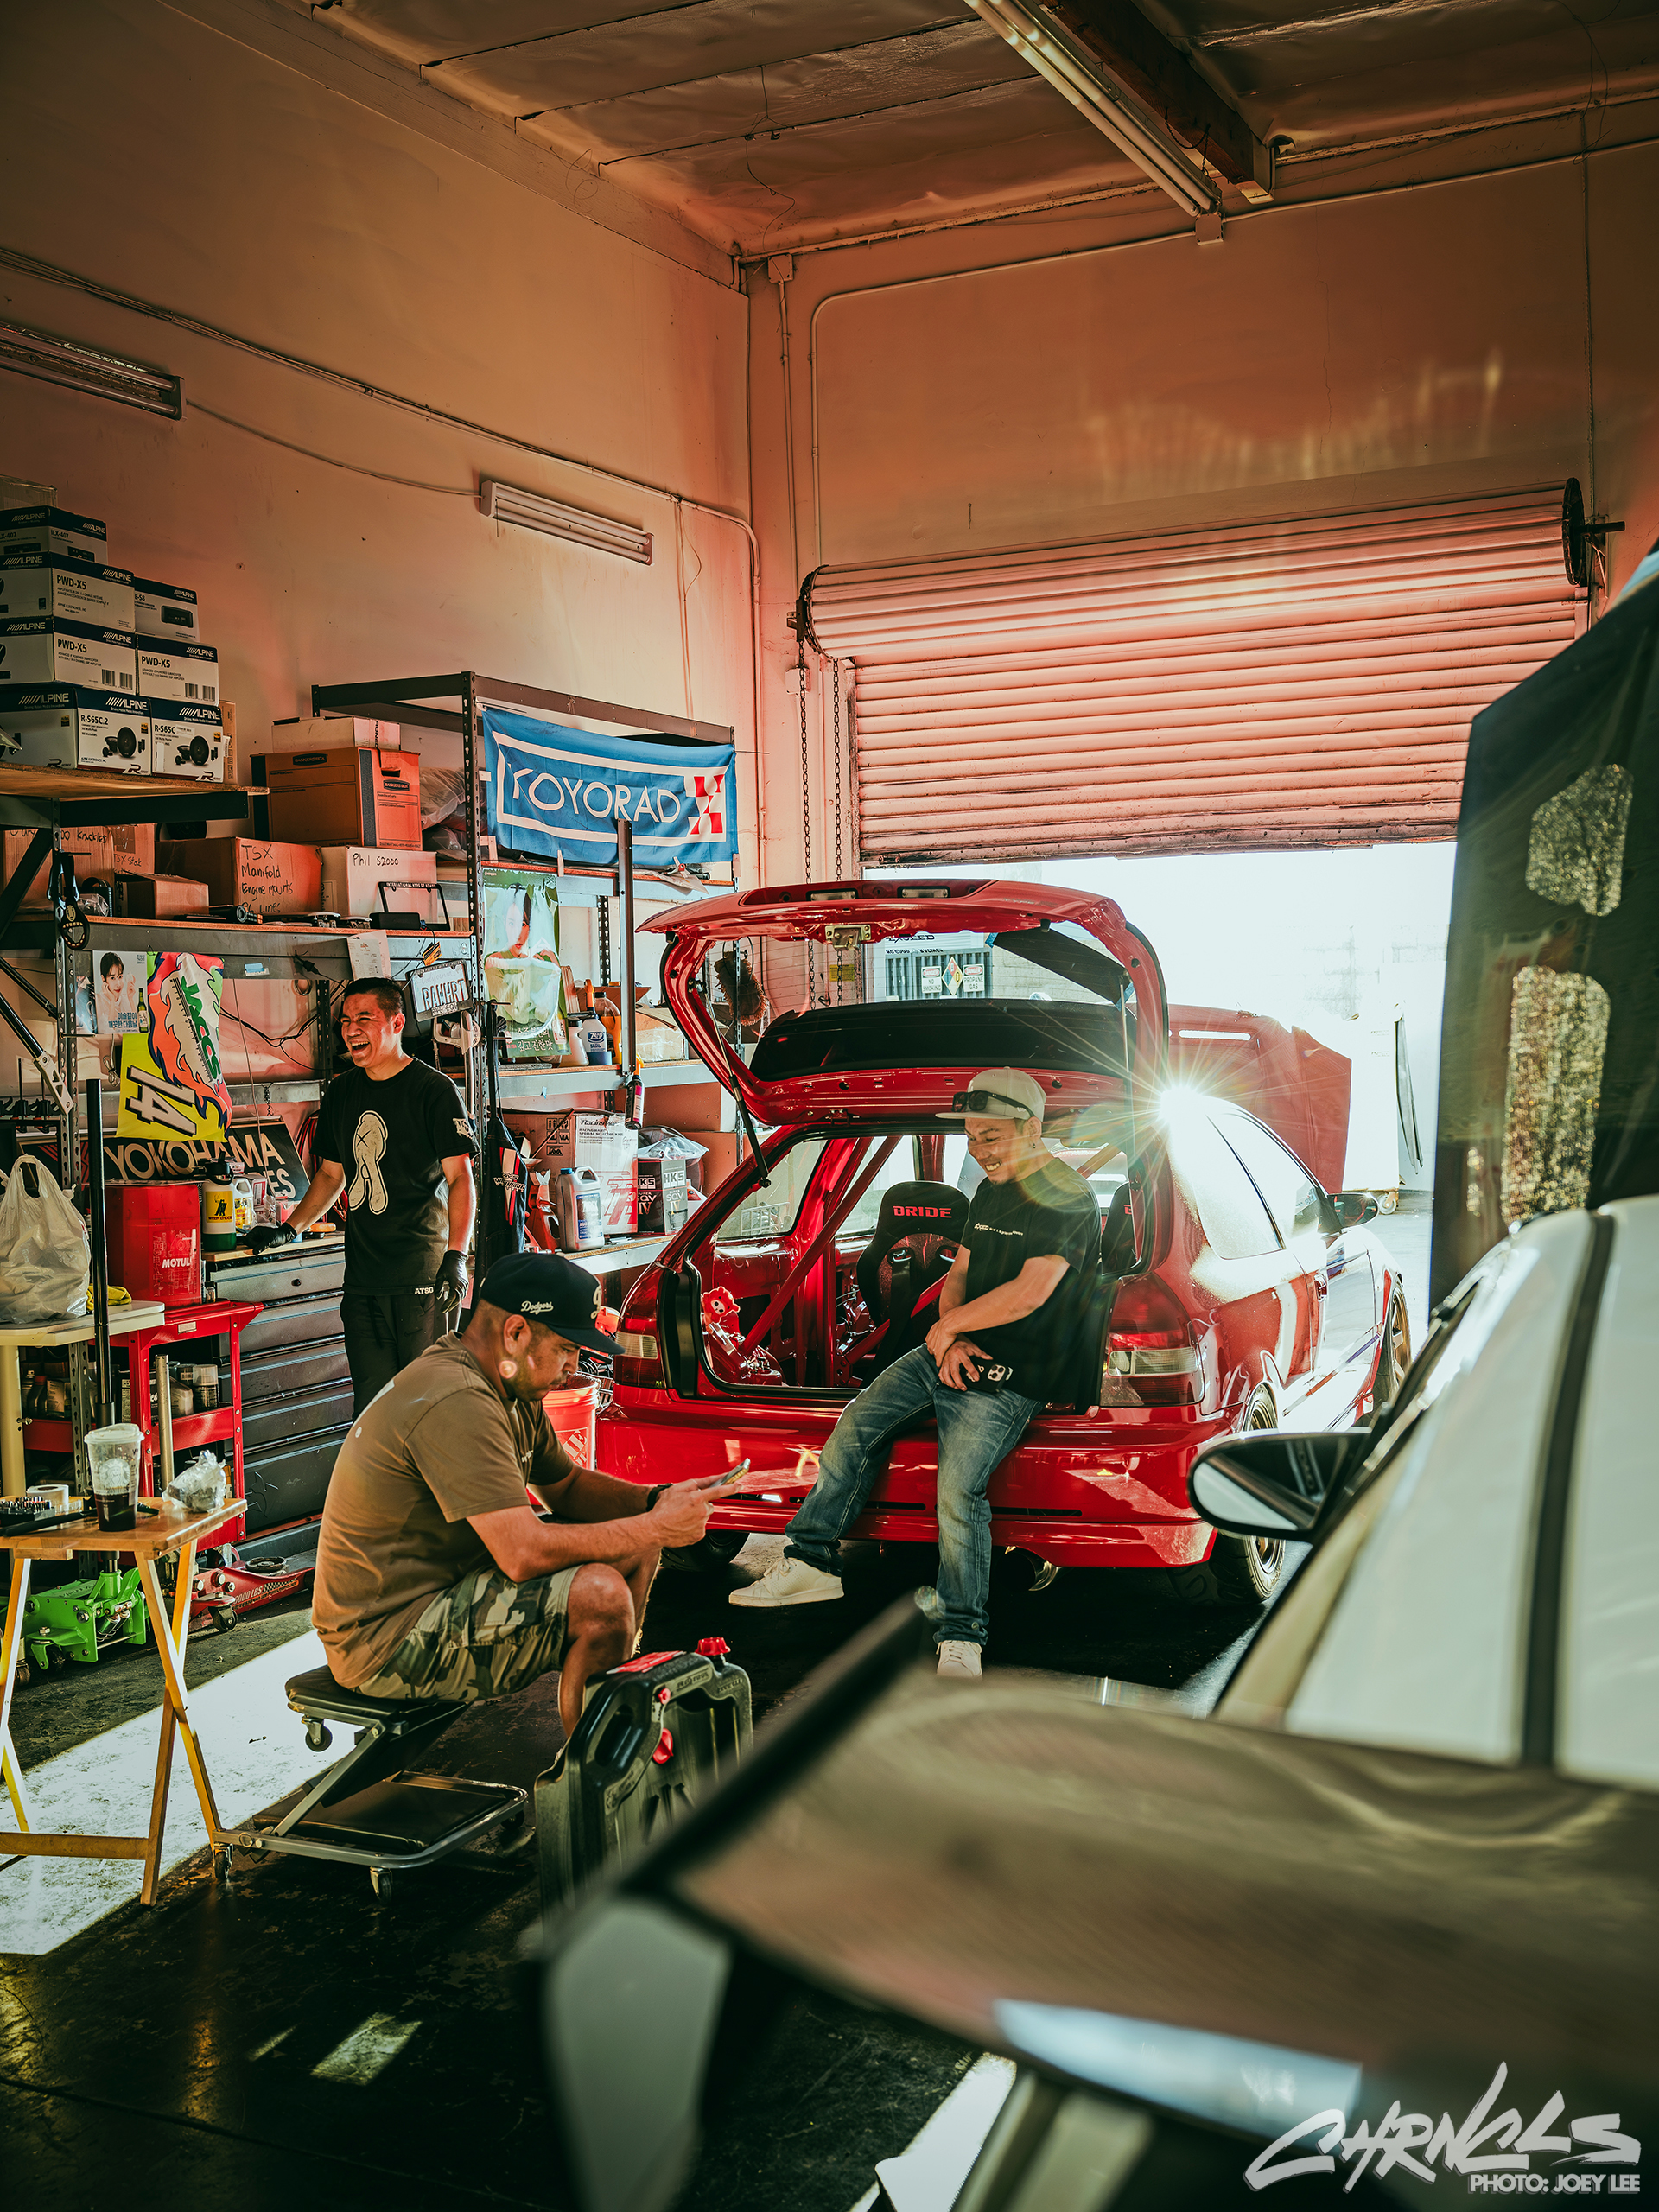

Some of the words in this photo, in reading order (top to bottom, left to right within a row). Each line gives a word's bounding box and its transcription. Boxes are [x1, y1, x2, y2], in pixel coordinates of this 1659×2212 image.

[16, 556, 43, 564] ALPINE
[56, 575, 87, 589] PWD-X5
[112, 571, 131, 582] ALPINE
[112, 633, 131, 644] ALPINE
[57, 639, 87, 653] PWD-X5
[194, 649, 214, 658] ALPINE
[141, 656, 171, 668] PWD-X5
[35, 693, 69, 704] ALPINE
[119, 698, 149, 710] ALPINE
[192, 708, 220, 720] ALPINE
[77, 831, 107, 843] Knuckles
[241, 844, 273, 861] TSX
[353, 852, 370, 867] Phil
[377, 856, 399, 866] S2000
[242, 862, 281, 879] Manifold
[242, 882, 265, 901] Engine
[422, 978, 464, 1011] RAWHRT
[181, 975, 221, 1080] JACCS
[125, 1065, 197, 1135] 14
[104, 1133, 285, 1180] YOKOHAMA
[664, 1172, 684, 1183] HKS
[665, 1192, 683, 1202] SQV
[638, 1202, 652, 1215] IV
[670, 1199, 681, 1216] IV
[893, 1205, 952, 1218] BRIDE
[162, 1257, 191, 1268] MOTUL
[520, 1300, 554, 1315] Dodgers
[251, 1586, 264, 1598] LBS
